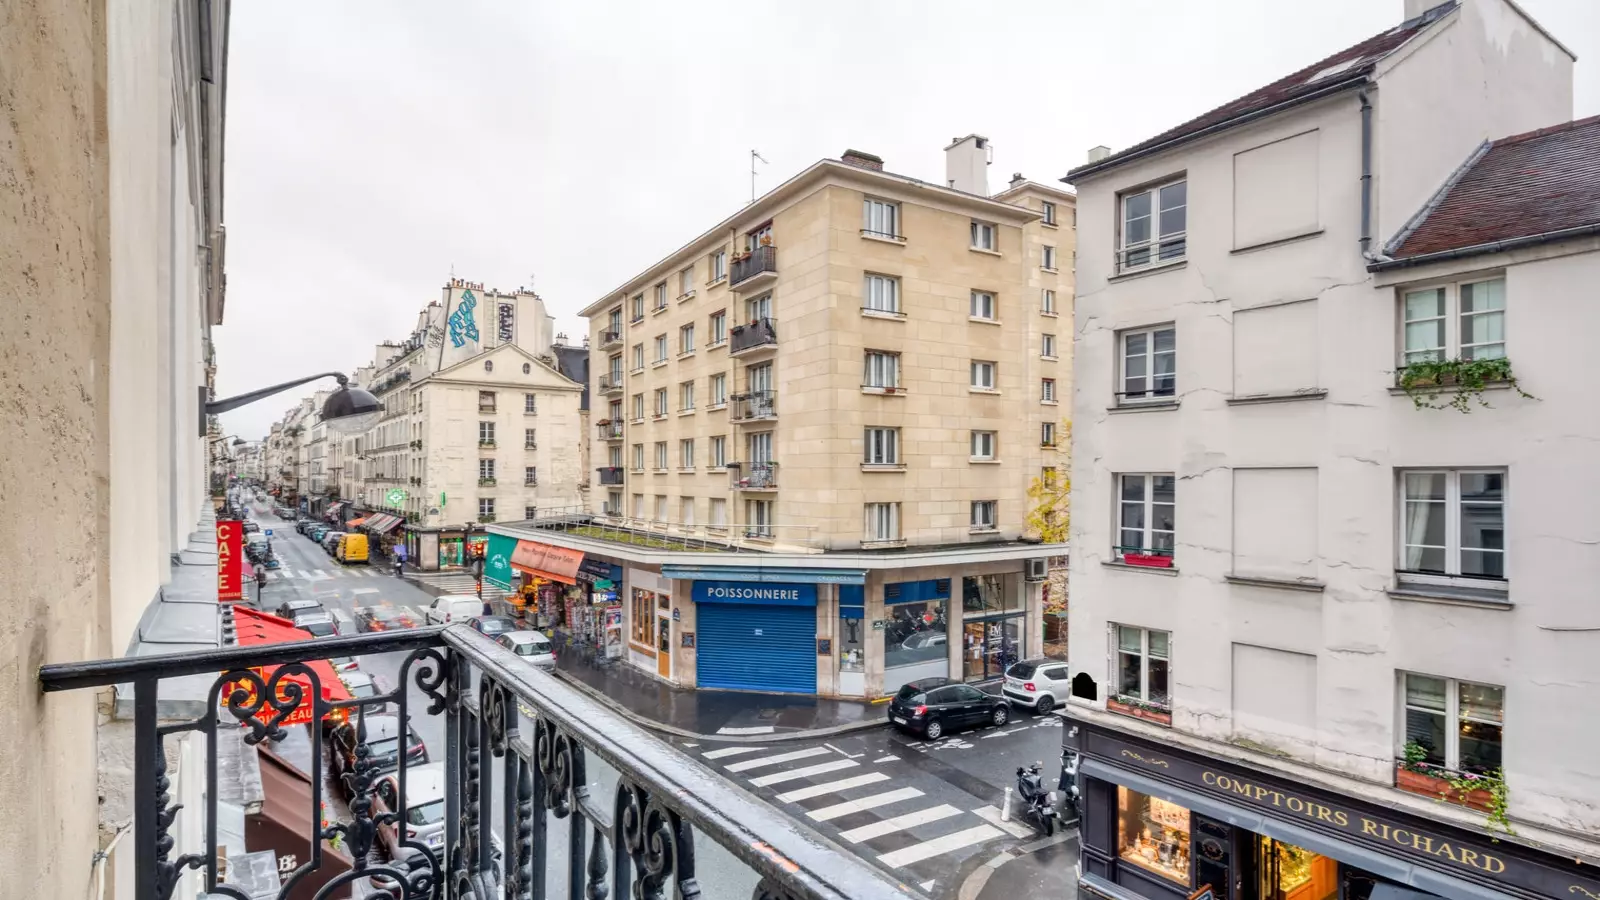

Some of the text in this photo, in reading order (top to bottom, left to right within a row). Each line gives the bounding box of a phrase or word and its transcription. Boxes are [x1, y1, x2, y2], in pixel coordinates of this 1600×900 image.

[217, 524, 231, 590] CAFE
[707, 587, 799, 601] POISSONNERIE
[1202, 771, 1506, 875] COMPTOIRS RICHARD
